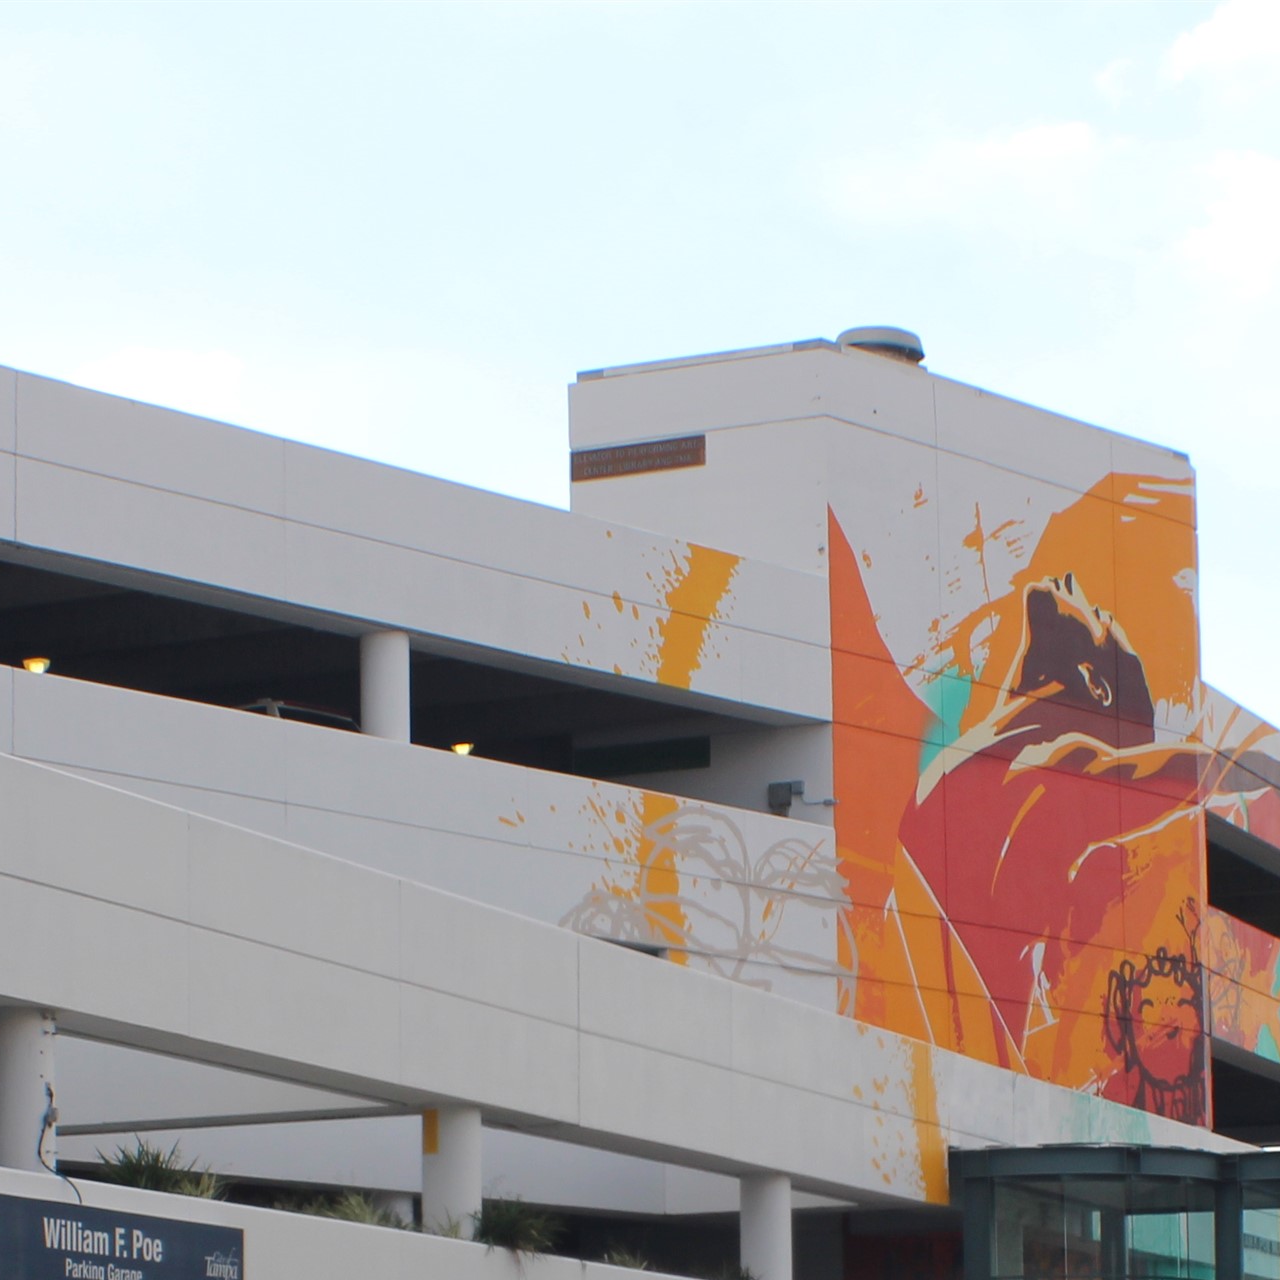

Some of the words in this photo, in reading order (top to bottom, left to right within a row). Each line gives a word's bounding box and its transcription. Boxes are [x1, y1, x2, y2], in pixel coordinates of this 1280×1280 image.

[43, 1216, 109, 1256] William
[114, 1227, 127, 1258] F.
[132, 1229, 163, 1263] Poe
